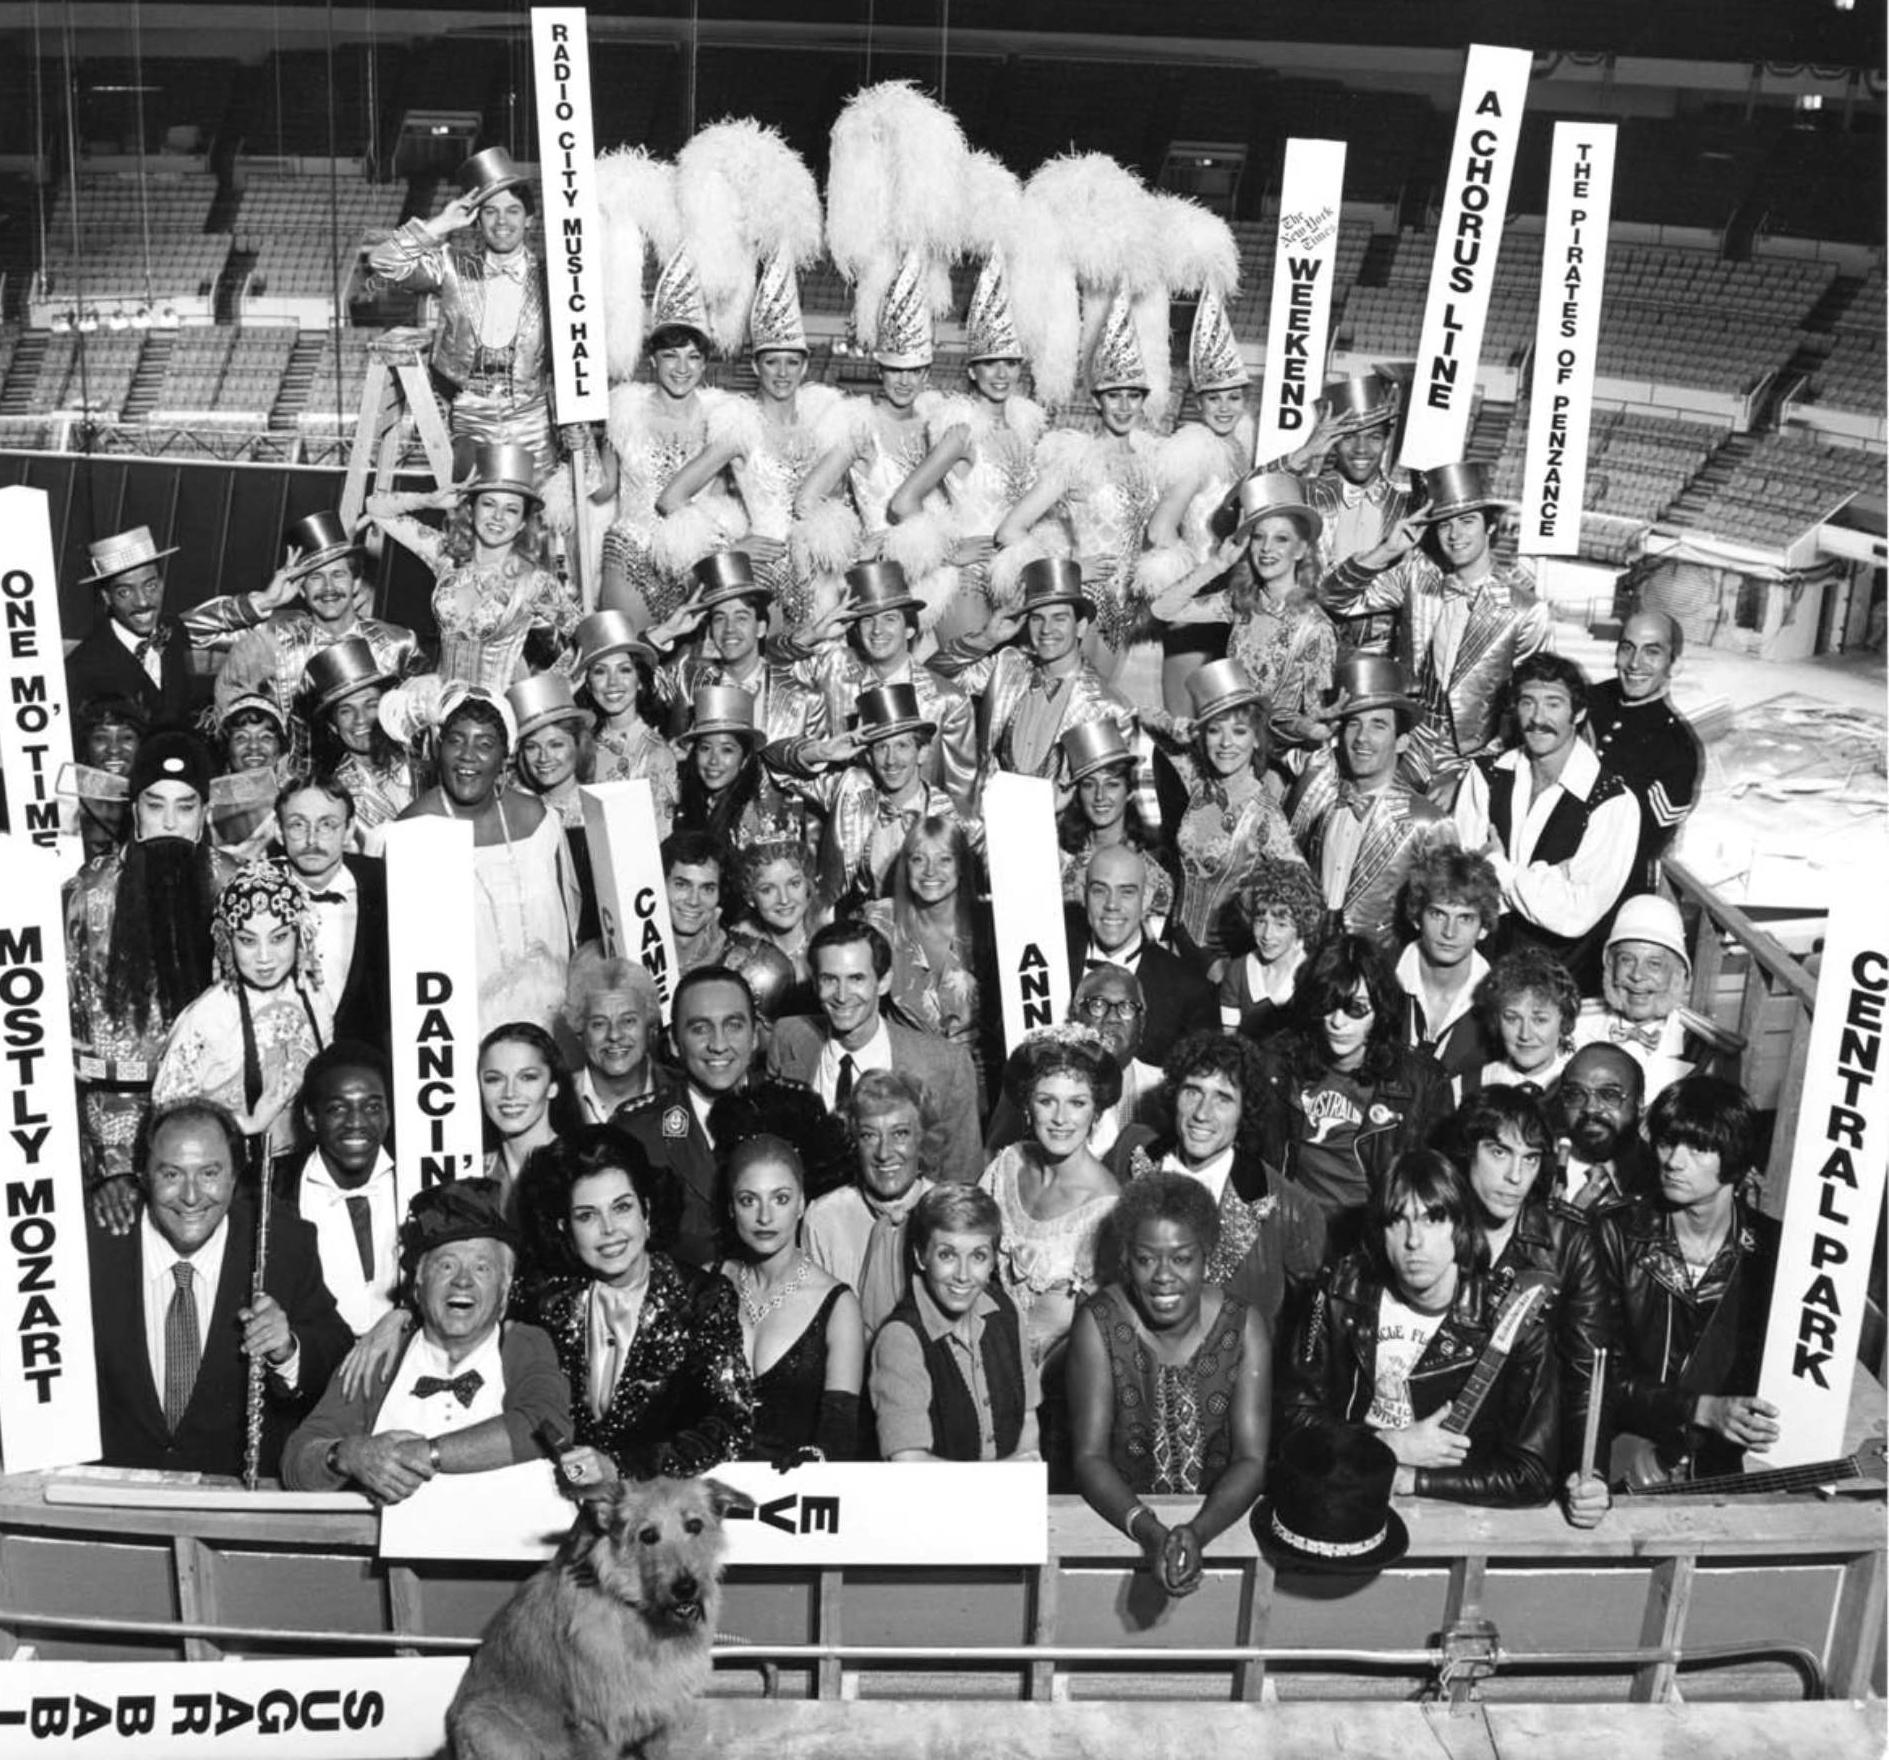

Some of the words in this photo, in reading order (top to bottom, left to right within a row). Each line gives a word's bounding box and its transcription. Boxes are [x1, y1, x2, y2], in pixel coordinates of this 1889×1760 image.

[551, 24, 575, 121] RADIO
[1475, 90, 1502, 118] A
[558, 131, 577, 208] CITY
[1449, 129, 1497, 294] CHORUS
[1573, 143, 1592, 199] THE
[562, 218, 585, 313] MUSIC
[1280, 227, 1306, 248] New
[1304, 206, 1334, 233] York
[1281, 211, 1303, 229] The
[1301, 224, 1336, 250] Times
[1557, 209, 1587, 338] PIRATES
[570, 322, 590, 397] HALL
[1278, 257, 1322, 431] WEEKEND
[1427, 303, 1463, 410] LINE
[1557, 349, 1576, 385] OF
[1539, 395, 1570, 537] PENZANCE
[1, 569, 39, 658] ONE
[10, 675, 61, 733] MO'
[1018, 943, 1053, 1030] ANN
[0, 925, 52, 1164] MOSTLY
[416, 971, 473, 1190] DANCIN'
[1818, 950, 1888, 1226] CENTRAL
[5, 1178, 62, 1404] MOZART
[1792, 1232, 1849, 1390] PARK
[171, 1688, 385, 1736] SUGAR
